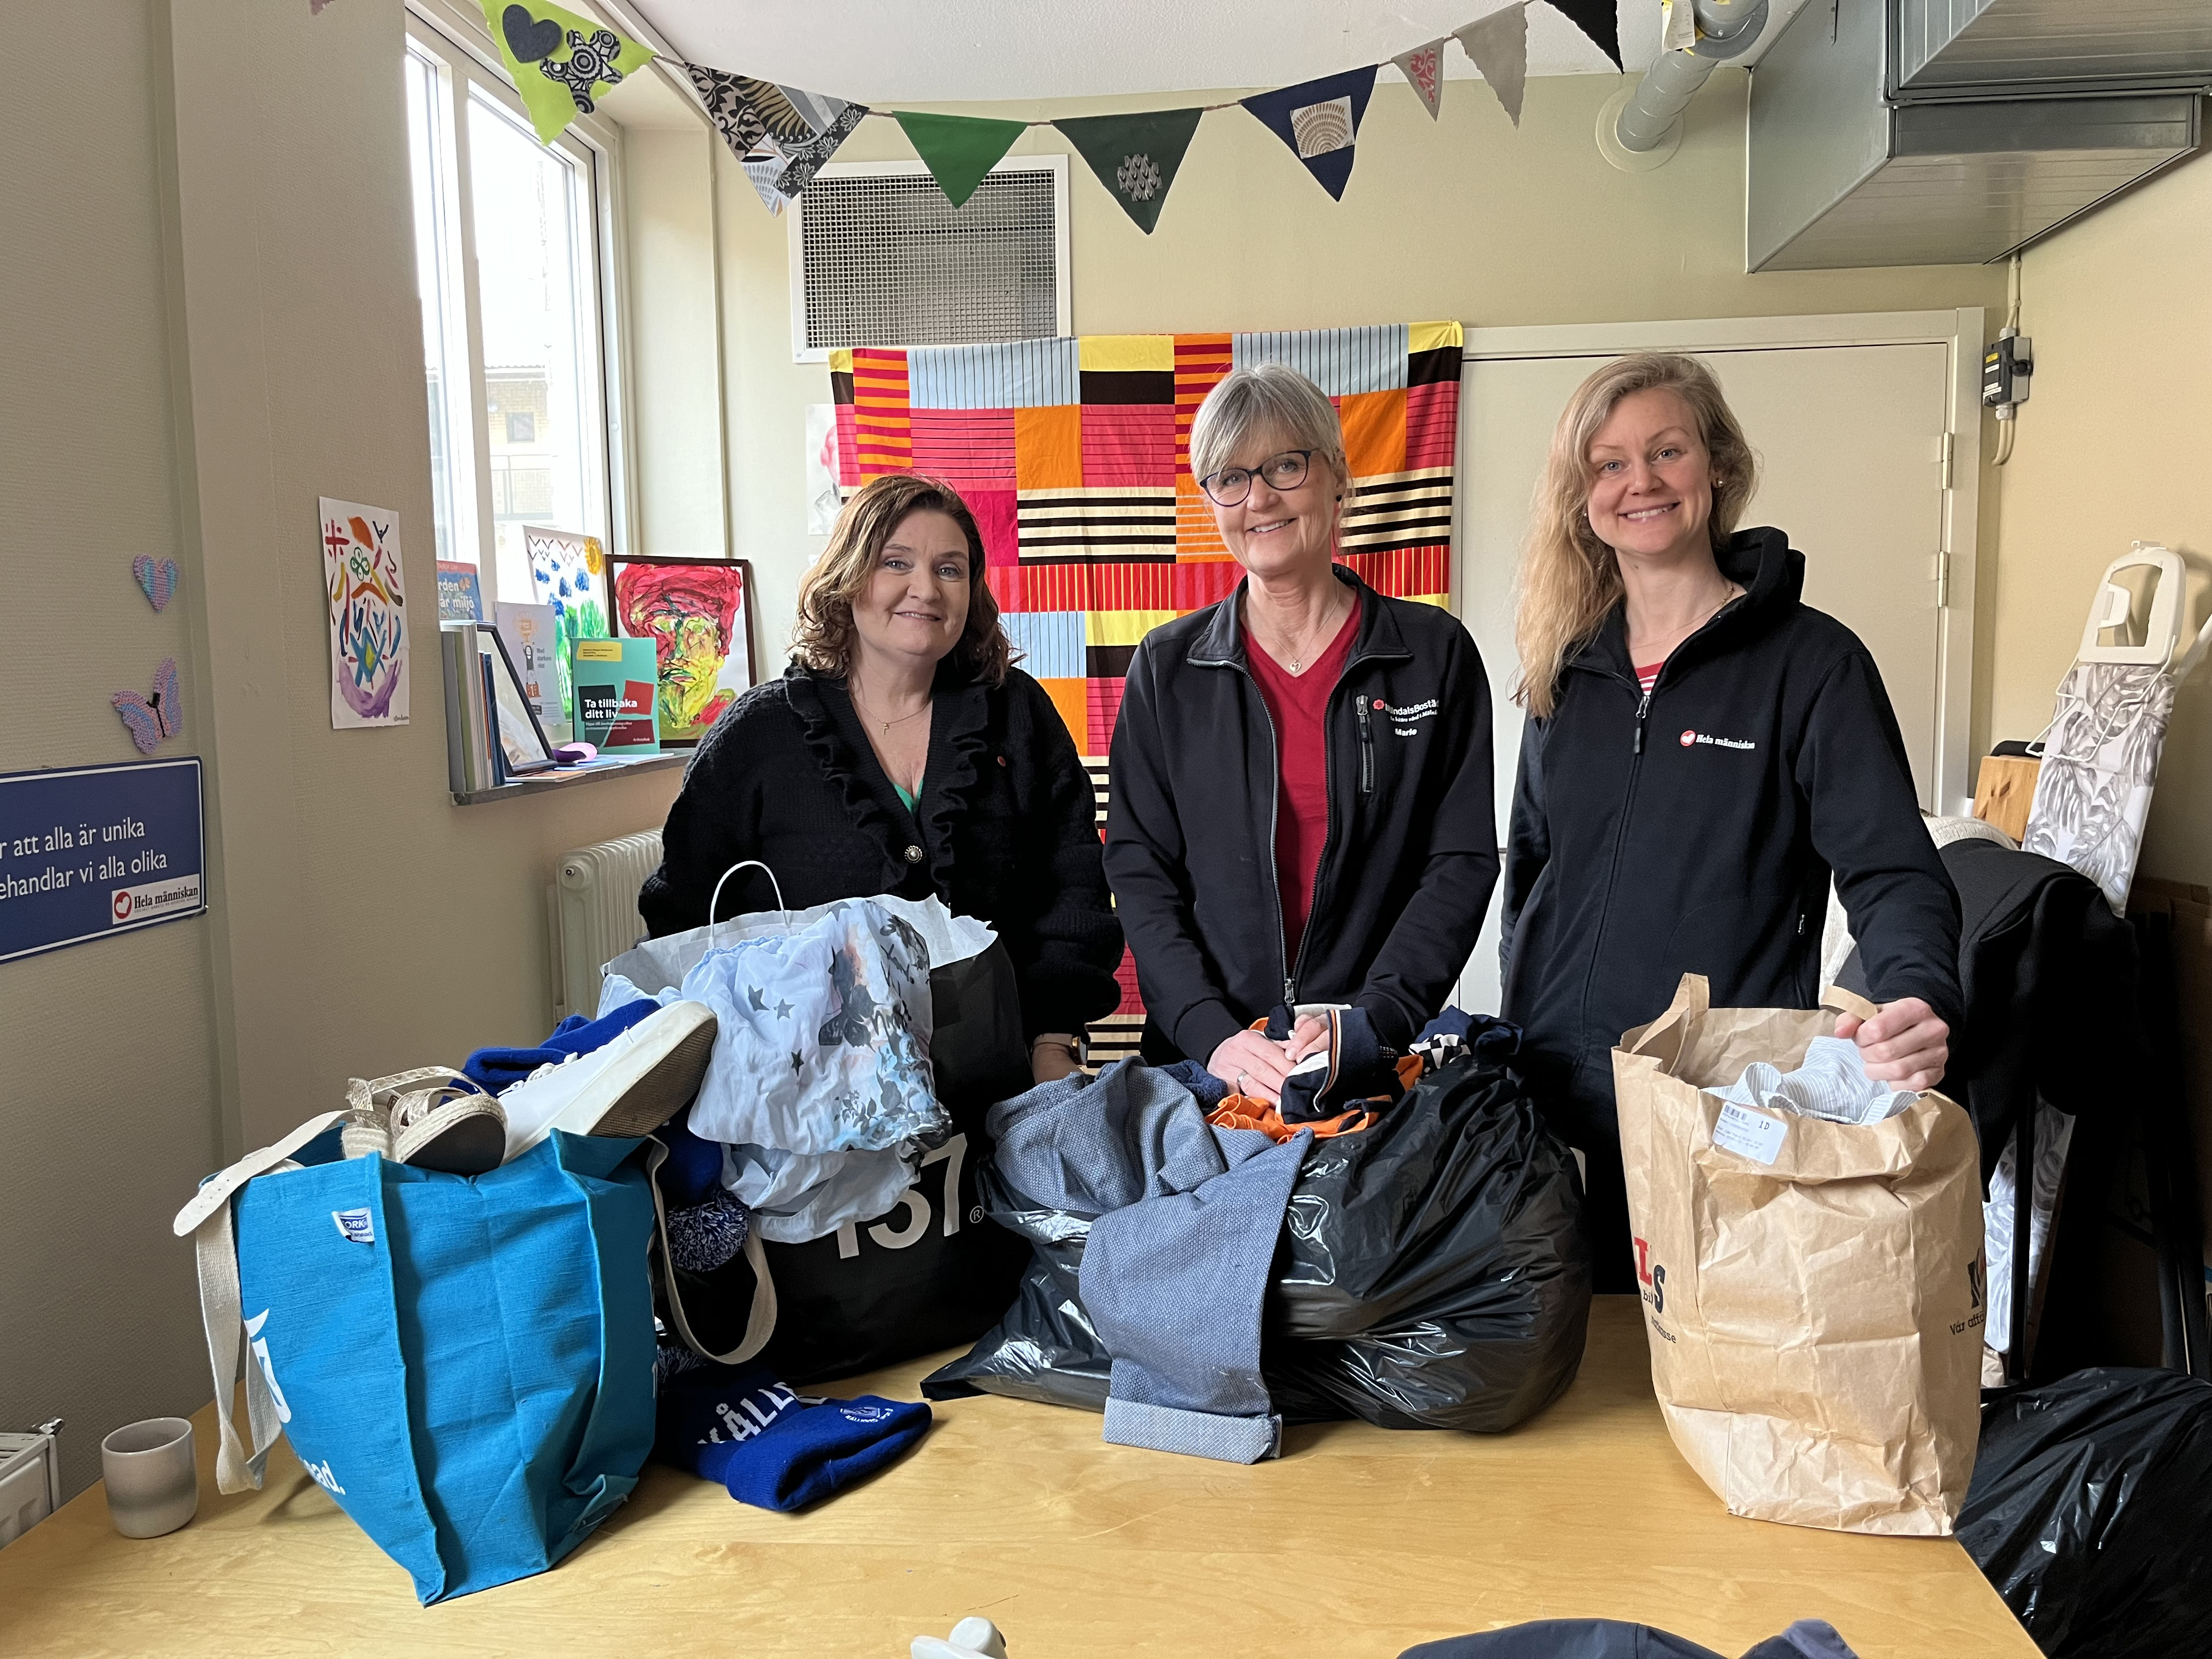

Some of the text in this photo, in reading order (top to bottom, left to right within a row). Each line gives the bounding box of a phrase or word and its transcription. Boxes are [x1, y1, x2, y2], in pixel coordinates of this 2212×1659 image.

[453, 595, 475, 612] miljö
[584, 698, 637, 708] Ta tillbaka
[585, 709, 618, 719] ditt liv
[1696, 734, 1714, 744] Hela
[14, 836, 39, 857] att
[45, 826, 74, 851] alla
[80, 824, 97, 846] är
[103, 816, 145, 842] unika
[79, 861, 93, 883] vi
[99, 856, 126, 880] alla
[131, 849, 168, 873] olika
[134, 894, 153, 909] Hela
[155, 886, 199, 904] människan
